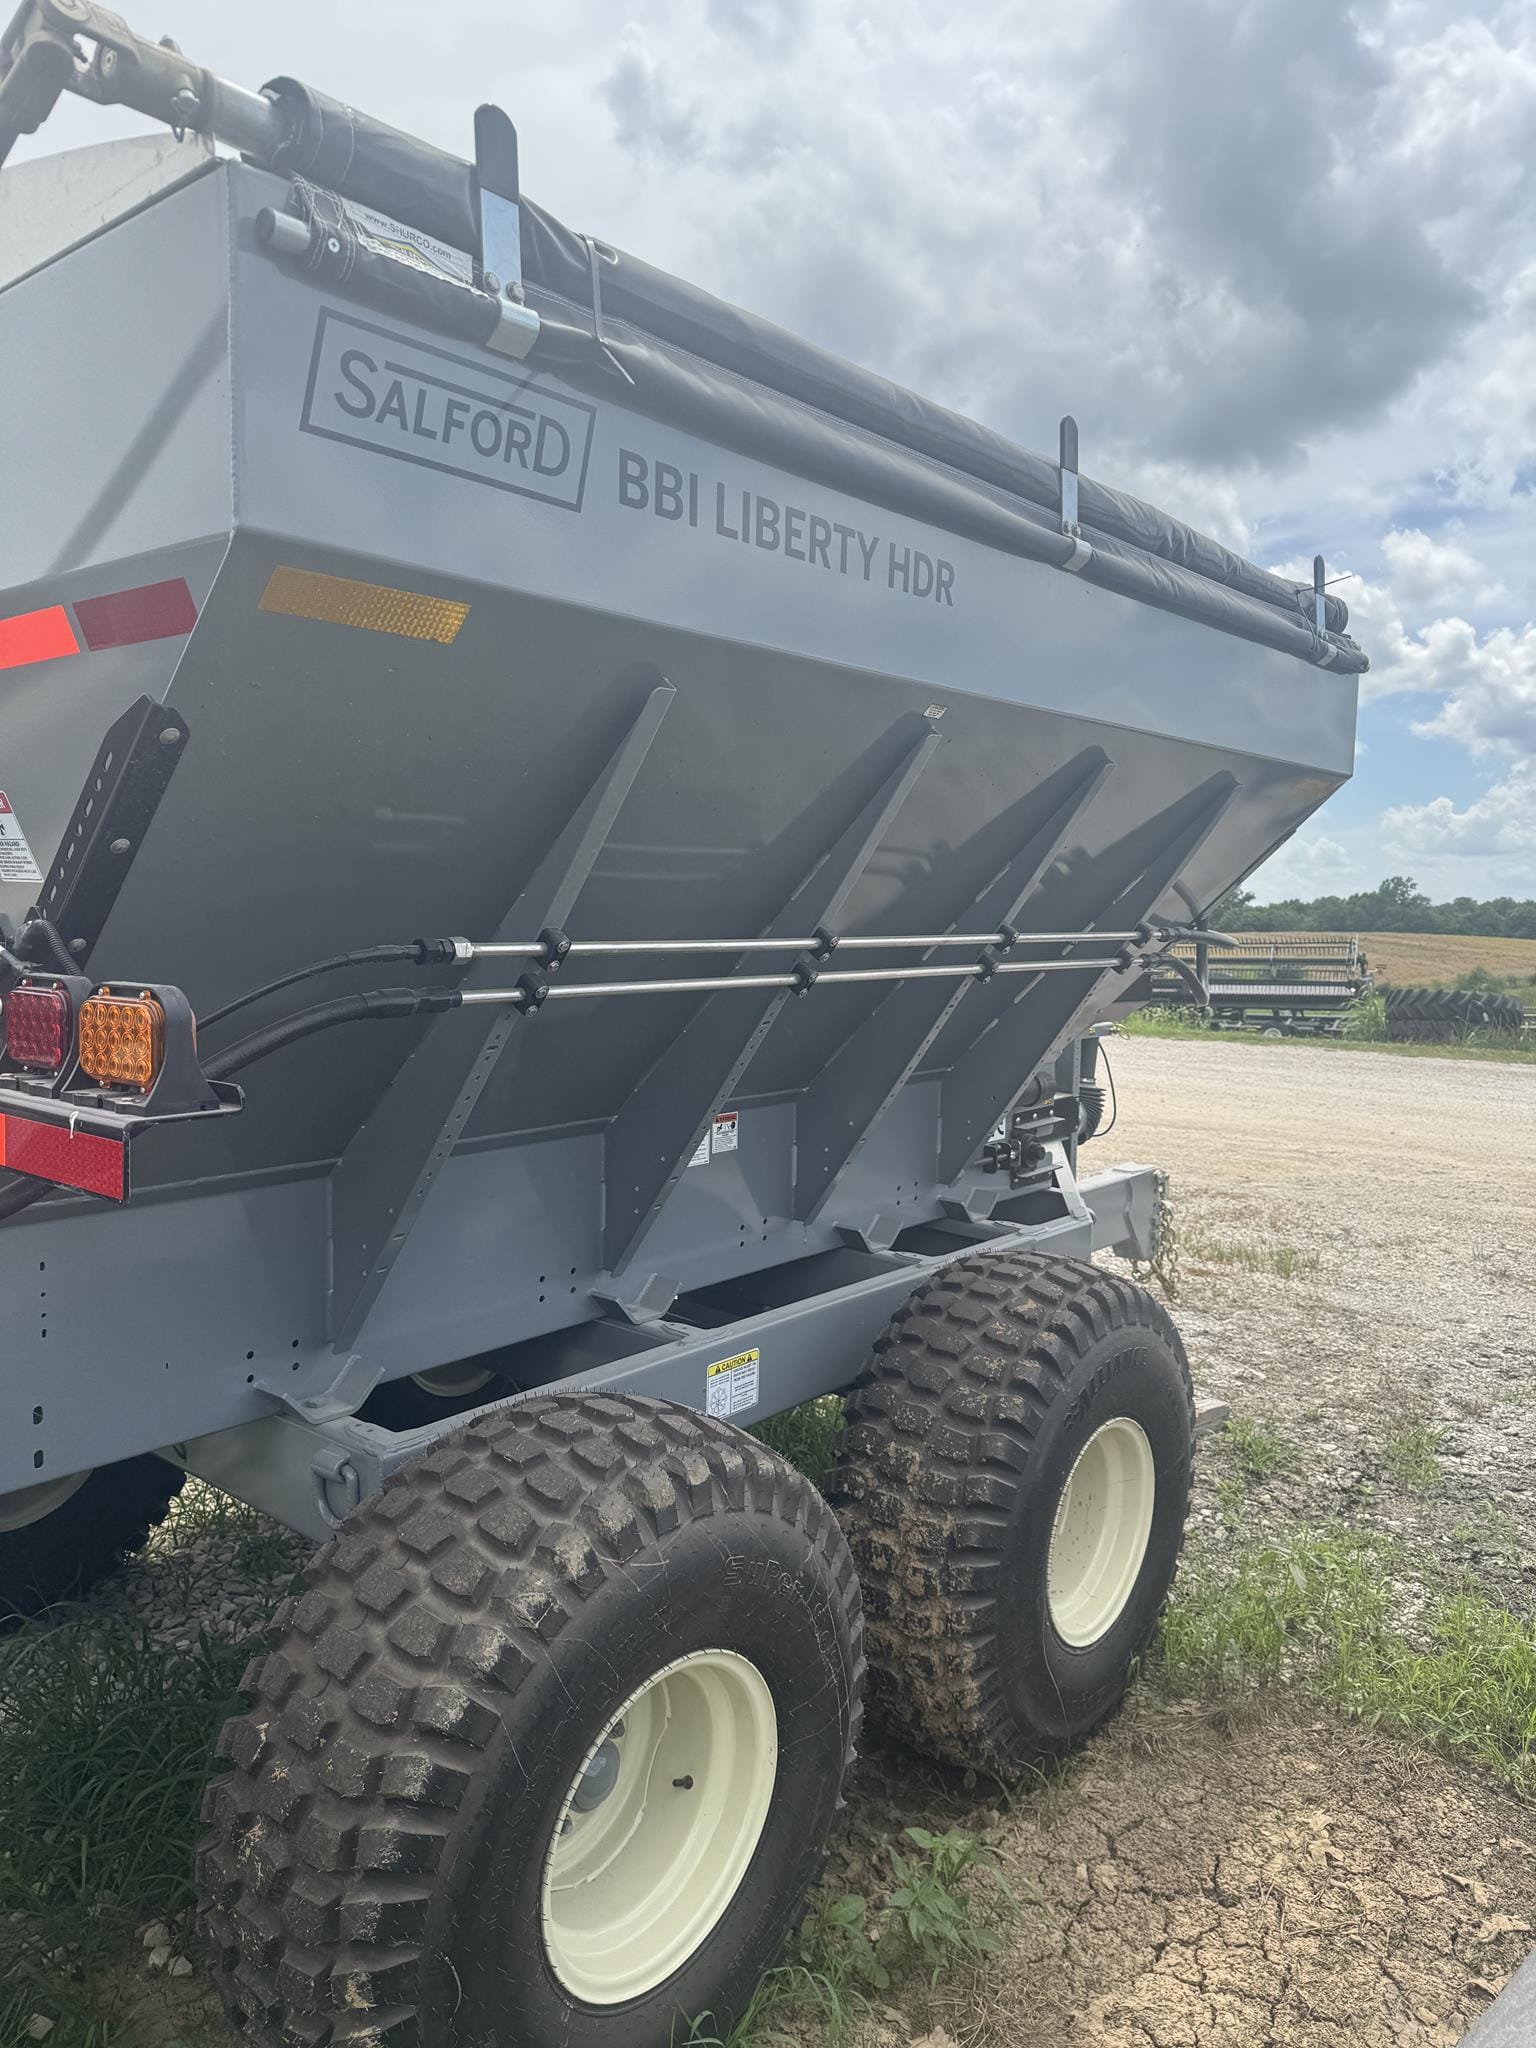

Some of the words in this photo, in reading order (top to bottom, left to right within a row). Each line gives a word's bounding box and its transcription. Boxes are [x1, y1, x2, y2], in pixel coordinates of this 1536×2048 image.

[364, 213, 452, 260] www.SHURCO.com
[334, 350, 570, 476] SALFORD
[619, 448, 698, 527] BBI
[716, 482, 879, 581] LIBERTY
[888, 542, 954, 606] HDR
[721, 1356, 746, 1371] CAUTION
